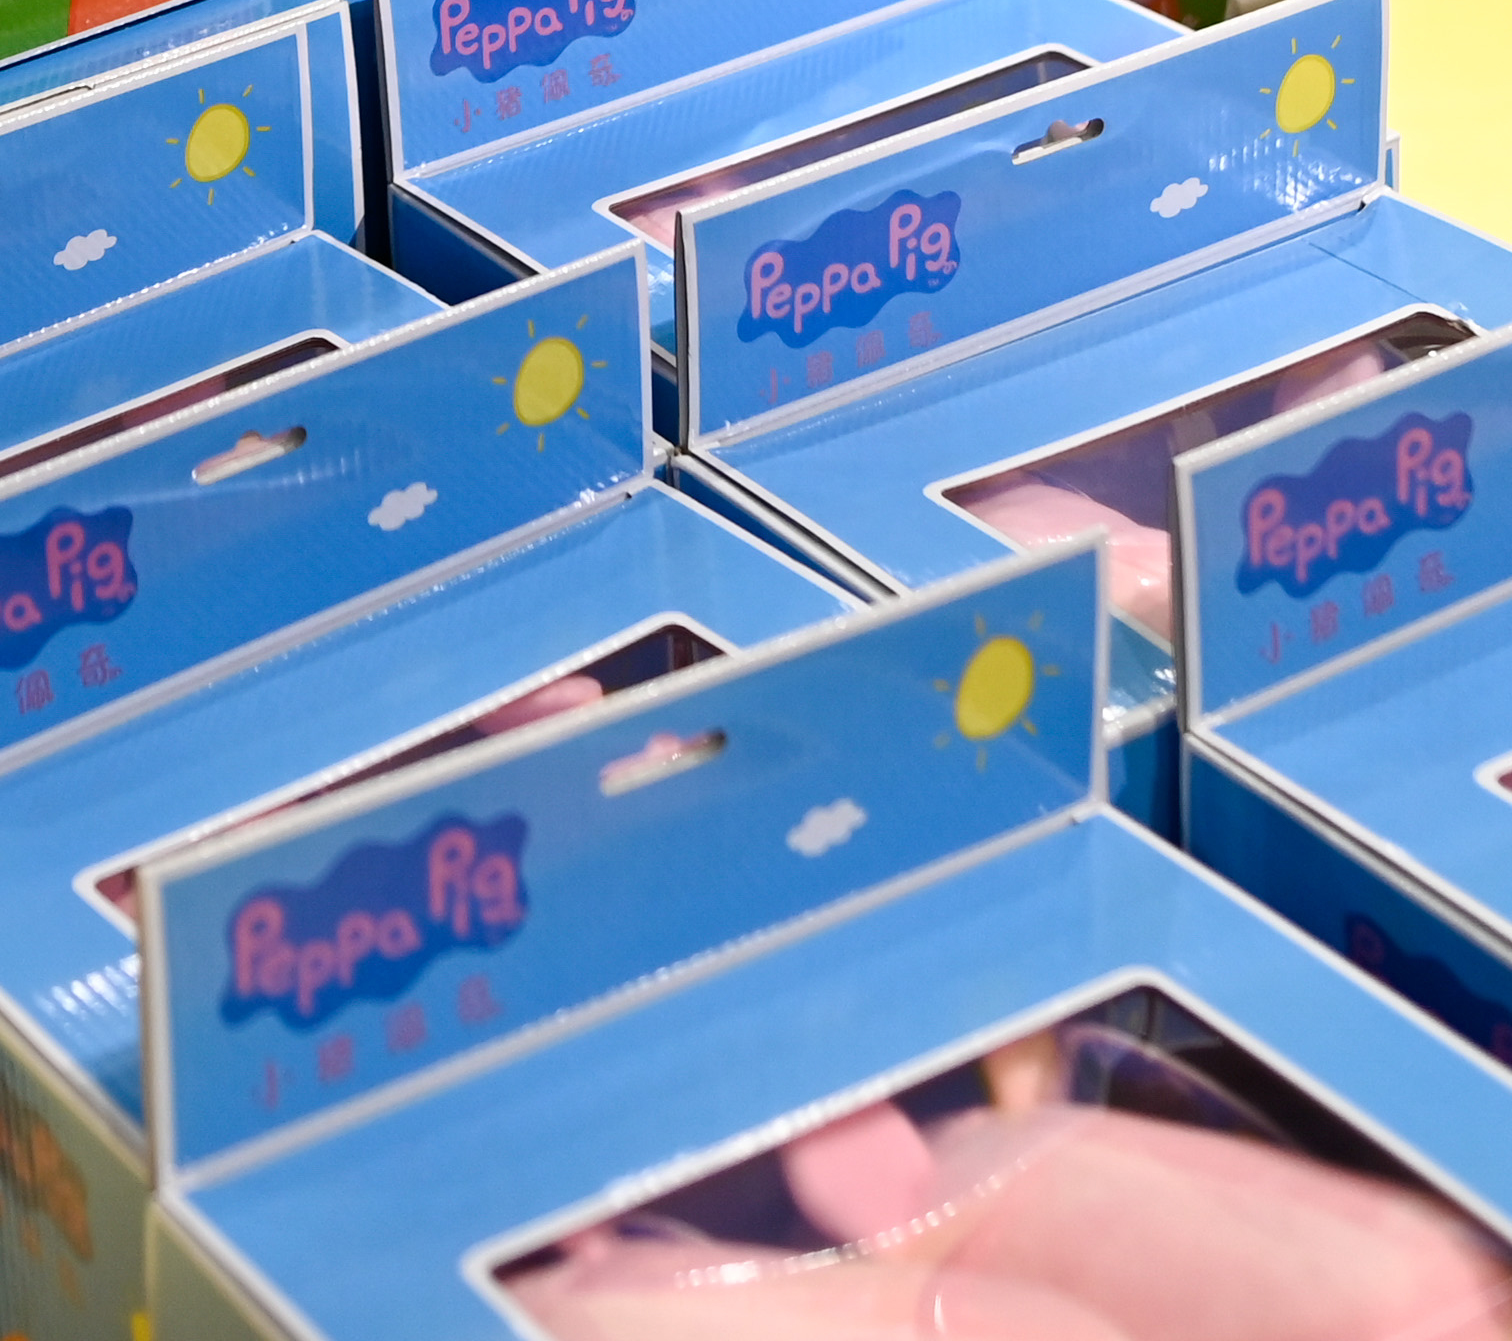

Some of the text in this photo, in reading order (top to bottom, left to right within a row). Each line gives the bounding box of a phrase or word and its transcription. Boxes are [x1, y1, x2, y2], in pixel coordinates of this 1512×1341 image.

[454, 53, 621, 133] 小猪佩奇
[750, 203, 957, 334] Peppa Pig
[45, 521, 135, 612] Pig
[1247, 427, 1471, 584] Peppa Pig
[233, 827, 529, 1017] Peppa Pig
